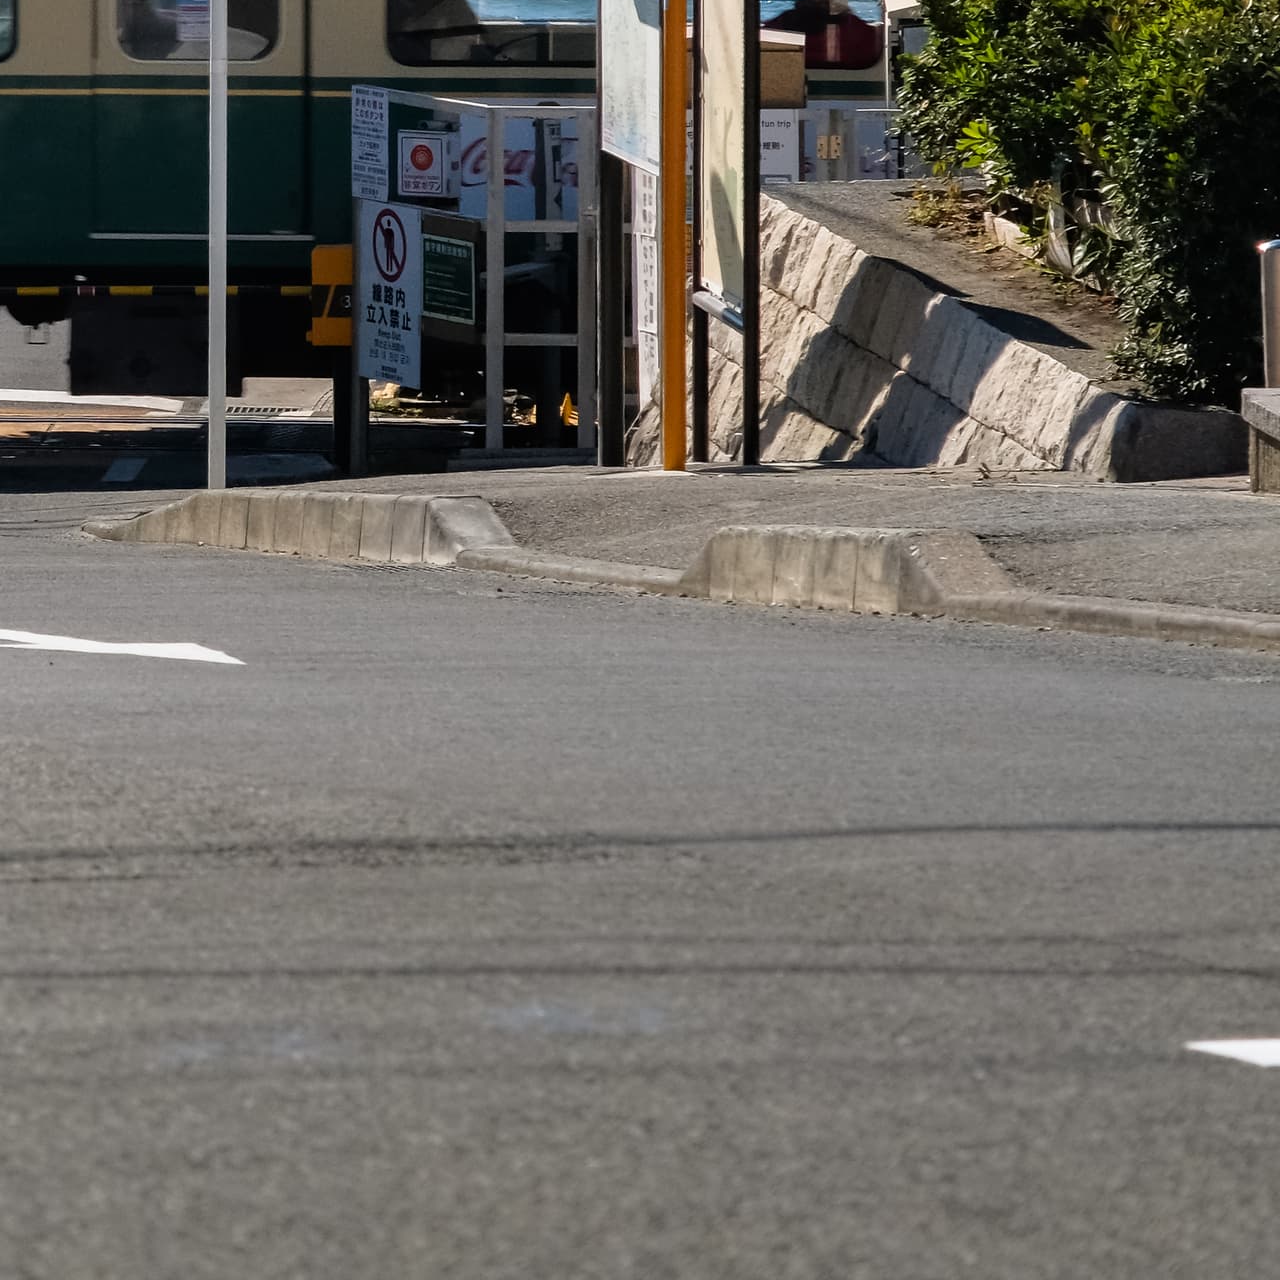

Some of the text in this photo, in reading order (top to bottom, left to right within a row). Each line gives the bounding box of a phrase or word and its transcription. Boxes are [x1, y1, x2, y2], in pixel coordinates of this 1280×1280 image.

[777, 120, 792, 129] trip
[372, 283, 406, 308] 線路内
[366, 304, 412, 332] 立入禁止
